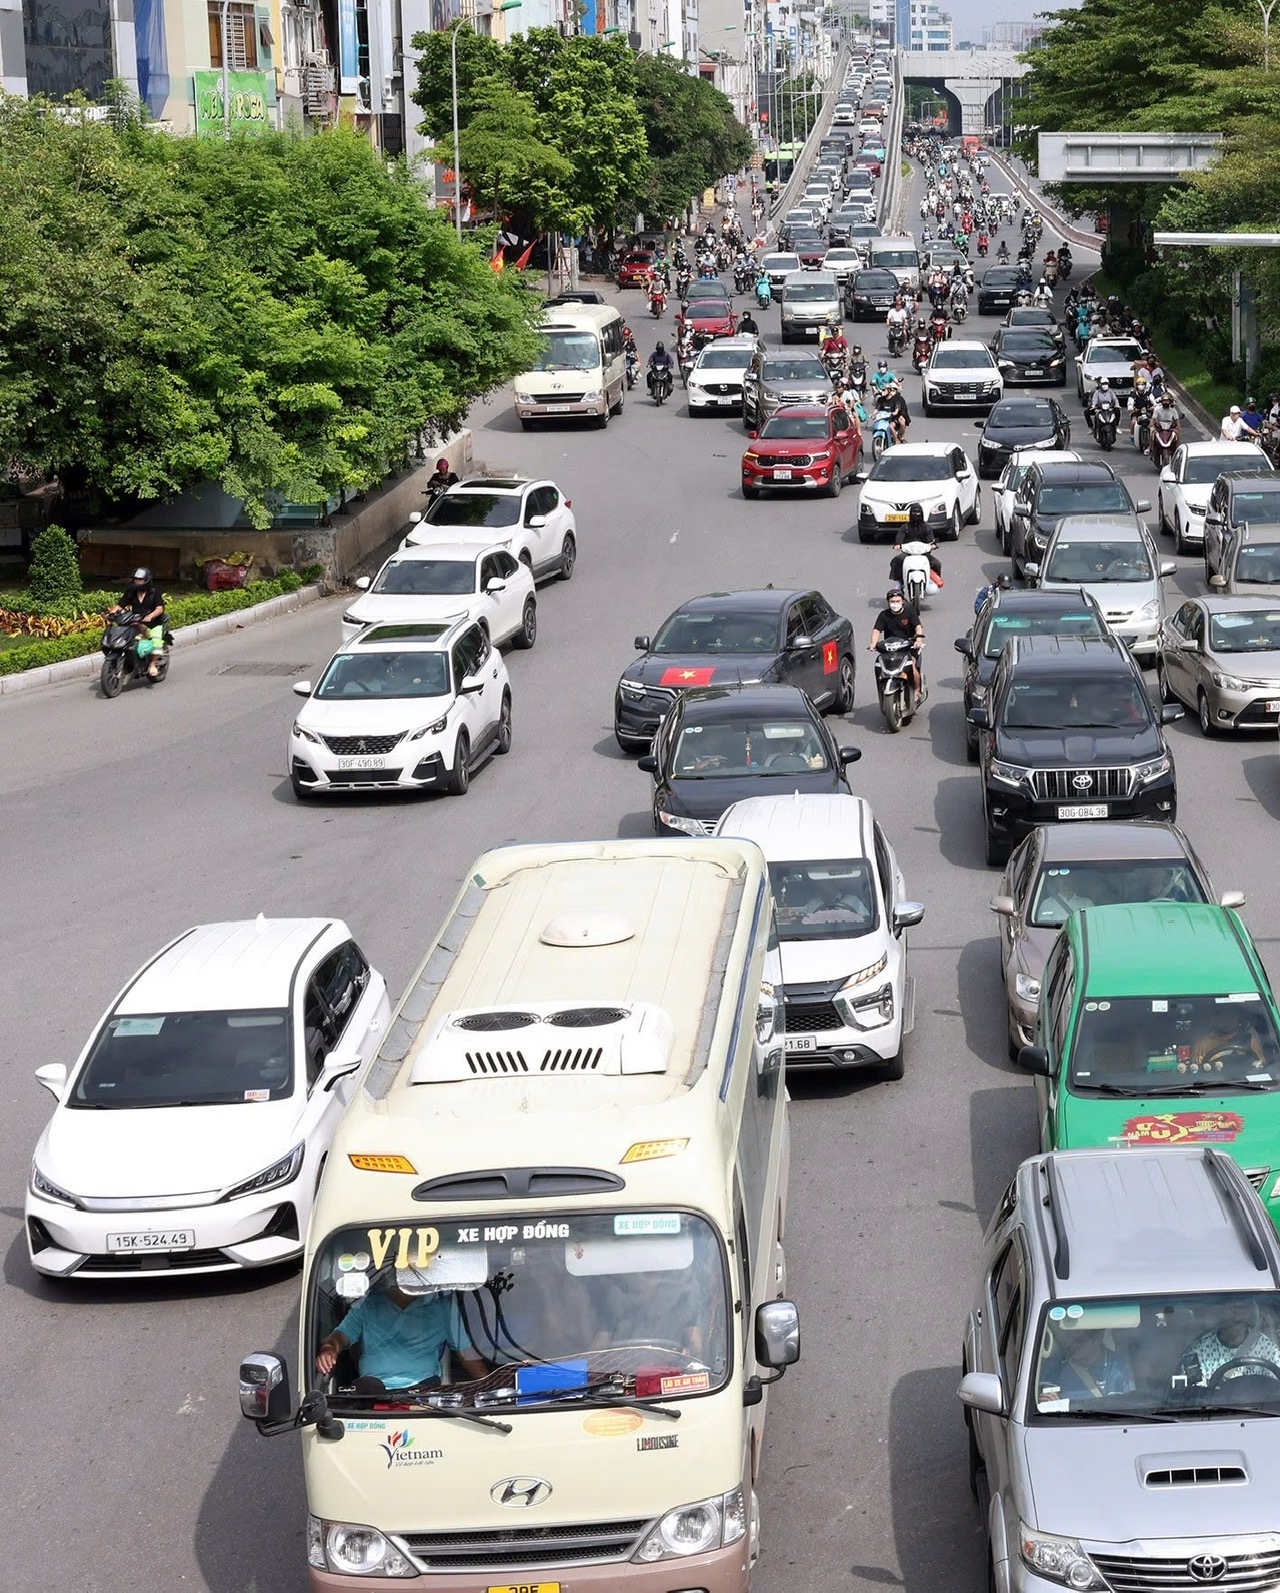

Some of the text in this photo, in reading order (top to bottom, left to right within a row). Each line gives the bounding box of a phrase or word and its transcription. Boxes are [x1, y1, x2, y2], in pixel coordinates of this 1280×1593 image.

[1060, 807, 1106, 818] 30G-084.36
[116, 1233, 187, 1247] 15K-524.49
[457, 1220, 570, 1244] XE HỢP ĐỒNG
[367, 1227, 440, 1270] VIP
[637, 1434, 679, 1451] LIMOUSINE
[378, 1444, 443, 1470] Vietnam
